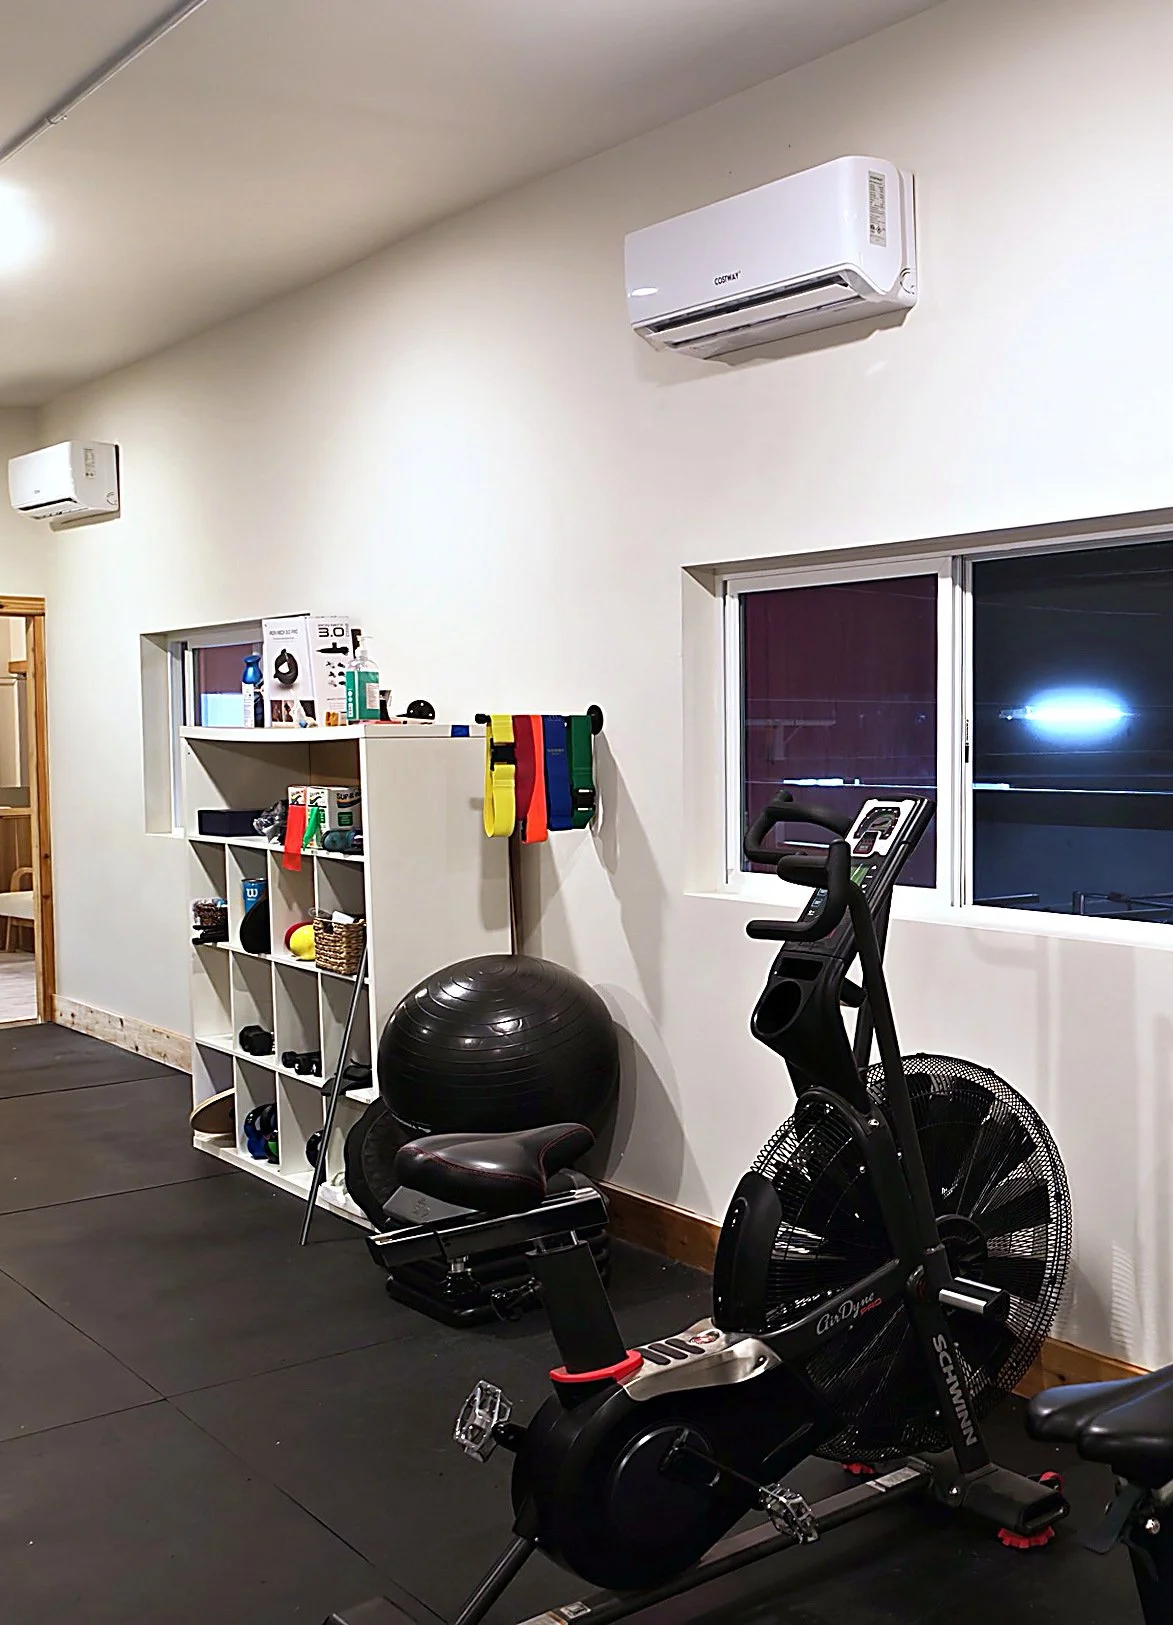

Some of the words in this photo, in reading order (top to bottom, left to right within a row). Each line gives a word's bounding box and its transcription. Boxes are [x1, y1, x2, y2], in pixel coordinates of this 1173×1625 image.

[714, 272, 739, 285] COSTWAY
[318, 627, 345, 638] 3.0
[860, 1297, 882, 1316] PRO
[932, 1334, 979, 1446] SCHWINN
